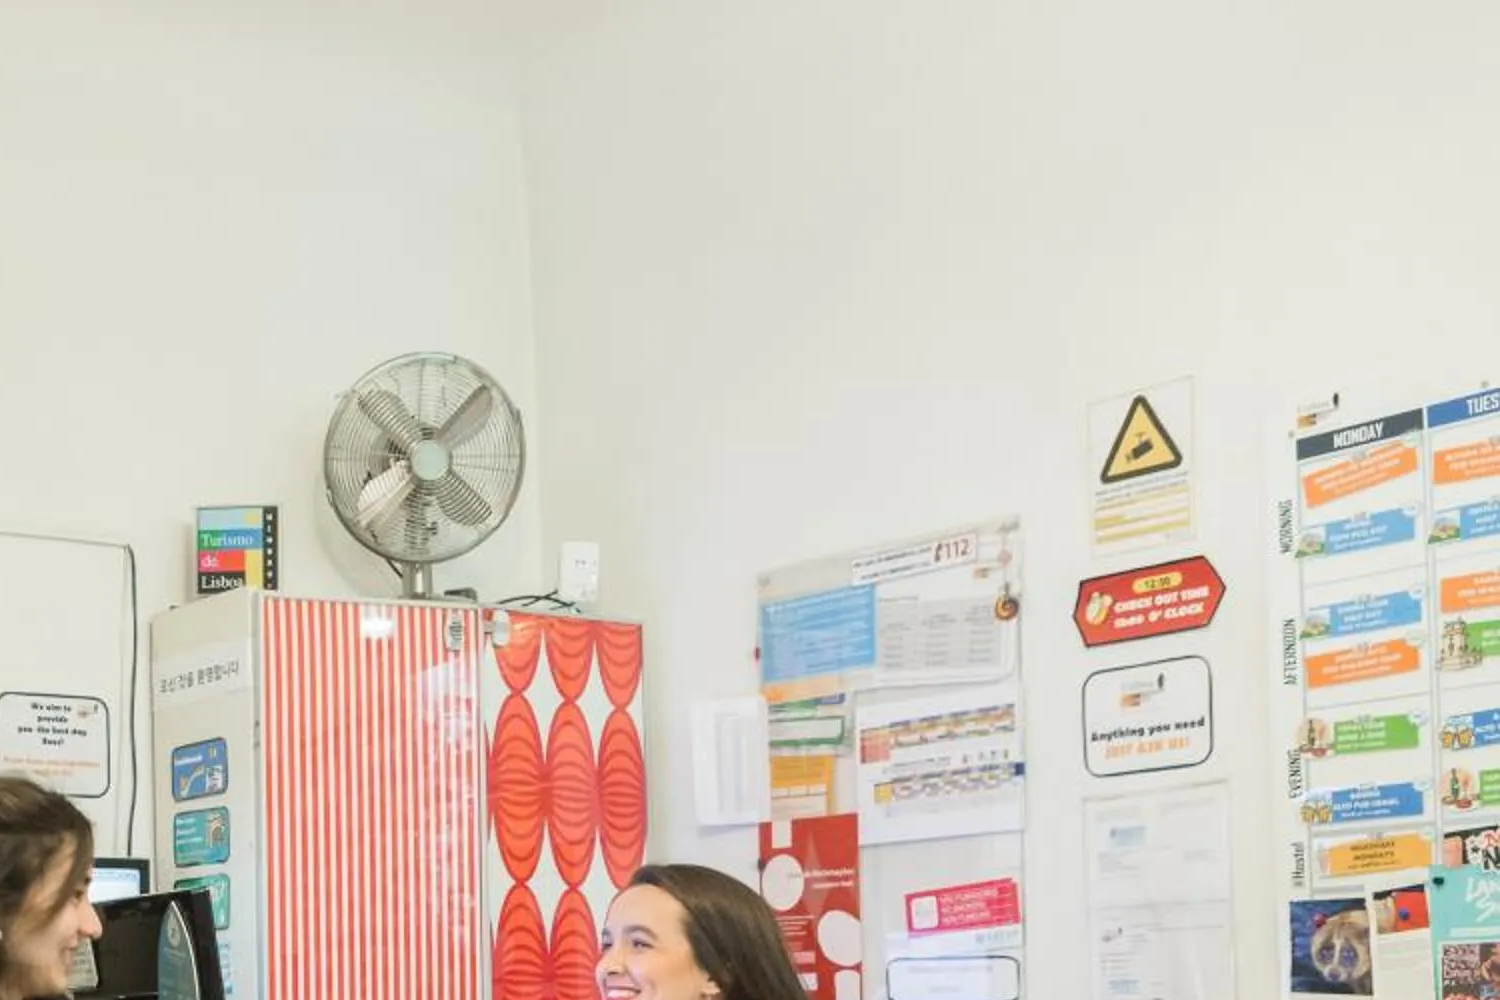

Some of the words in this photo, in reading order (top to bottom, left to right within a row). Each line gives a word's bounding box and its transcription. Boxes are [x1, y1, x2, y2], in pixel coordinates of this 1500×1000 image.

[1333, 421, 1384, 448] MONDAY
[201, 533, 253, 547] Turismo
[1148, 723, 1170, 737] you
[1175, 716, 1205, 730] need
